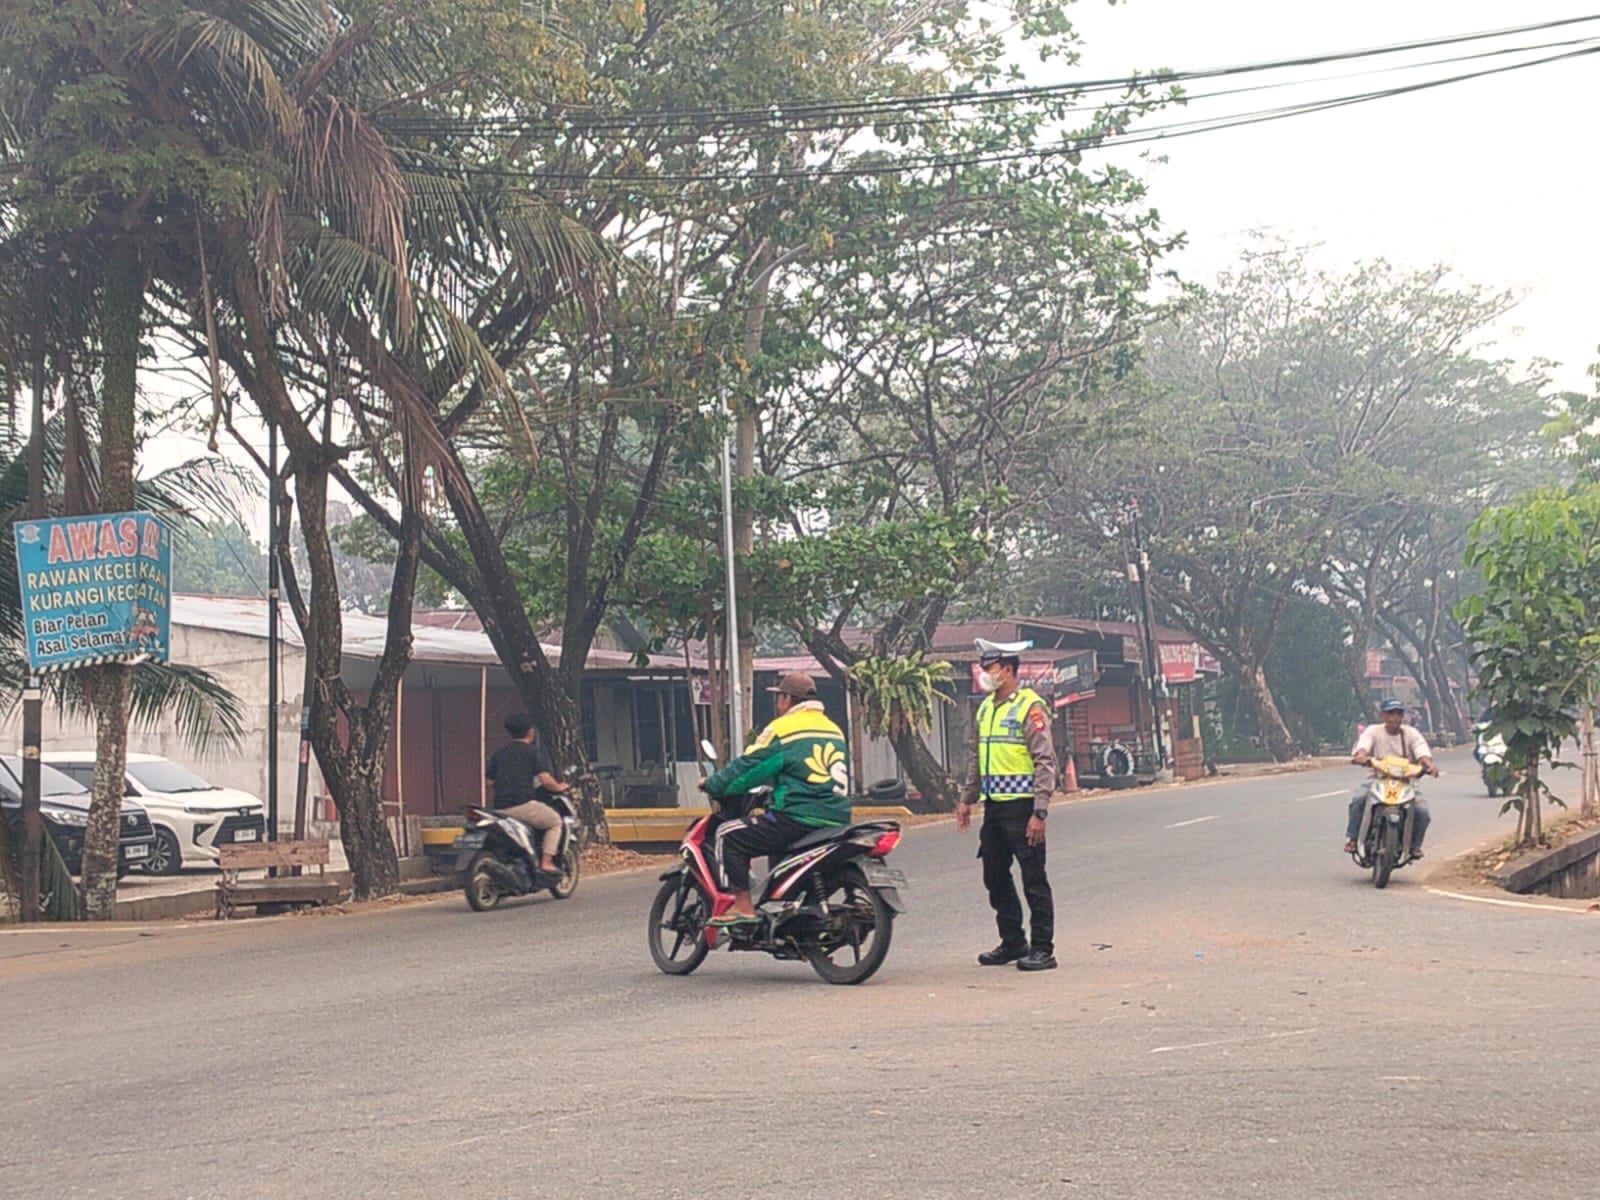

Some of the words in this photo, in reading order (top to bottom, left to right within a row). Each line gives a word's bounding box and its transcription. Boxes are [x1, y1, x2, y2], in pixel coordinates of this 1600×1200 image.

[48, 519, 138, 563] AWAS
[27, 567, 90, 590] RAWAN
[29, 588, 104, 612] KURANGI
[34, 617, 66, 634] Biar
[67, 613, 106, 630] Pelan
[36, 637, 66, 656] Asal
